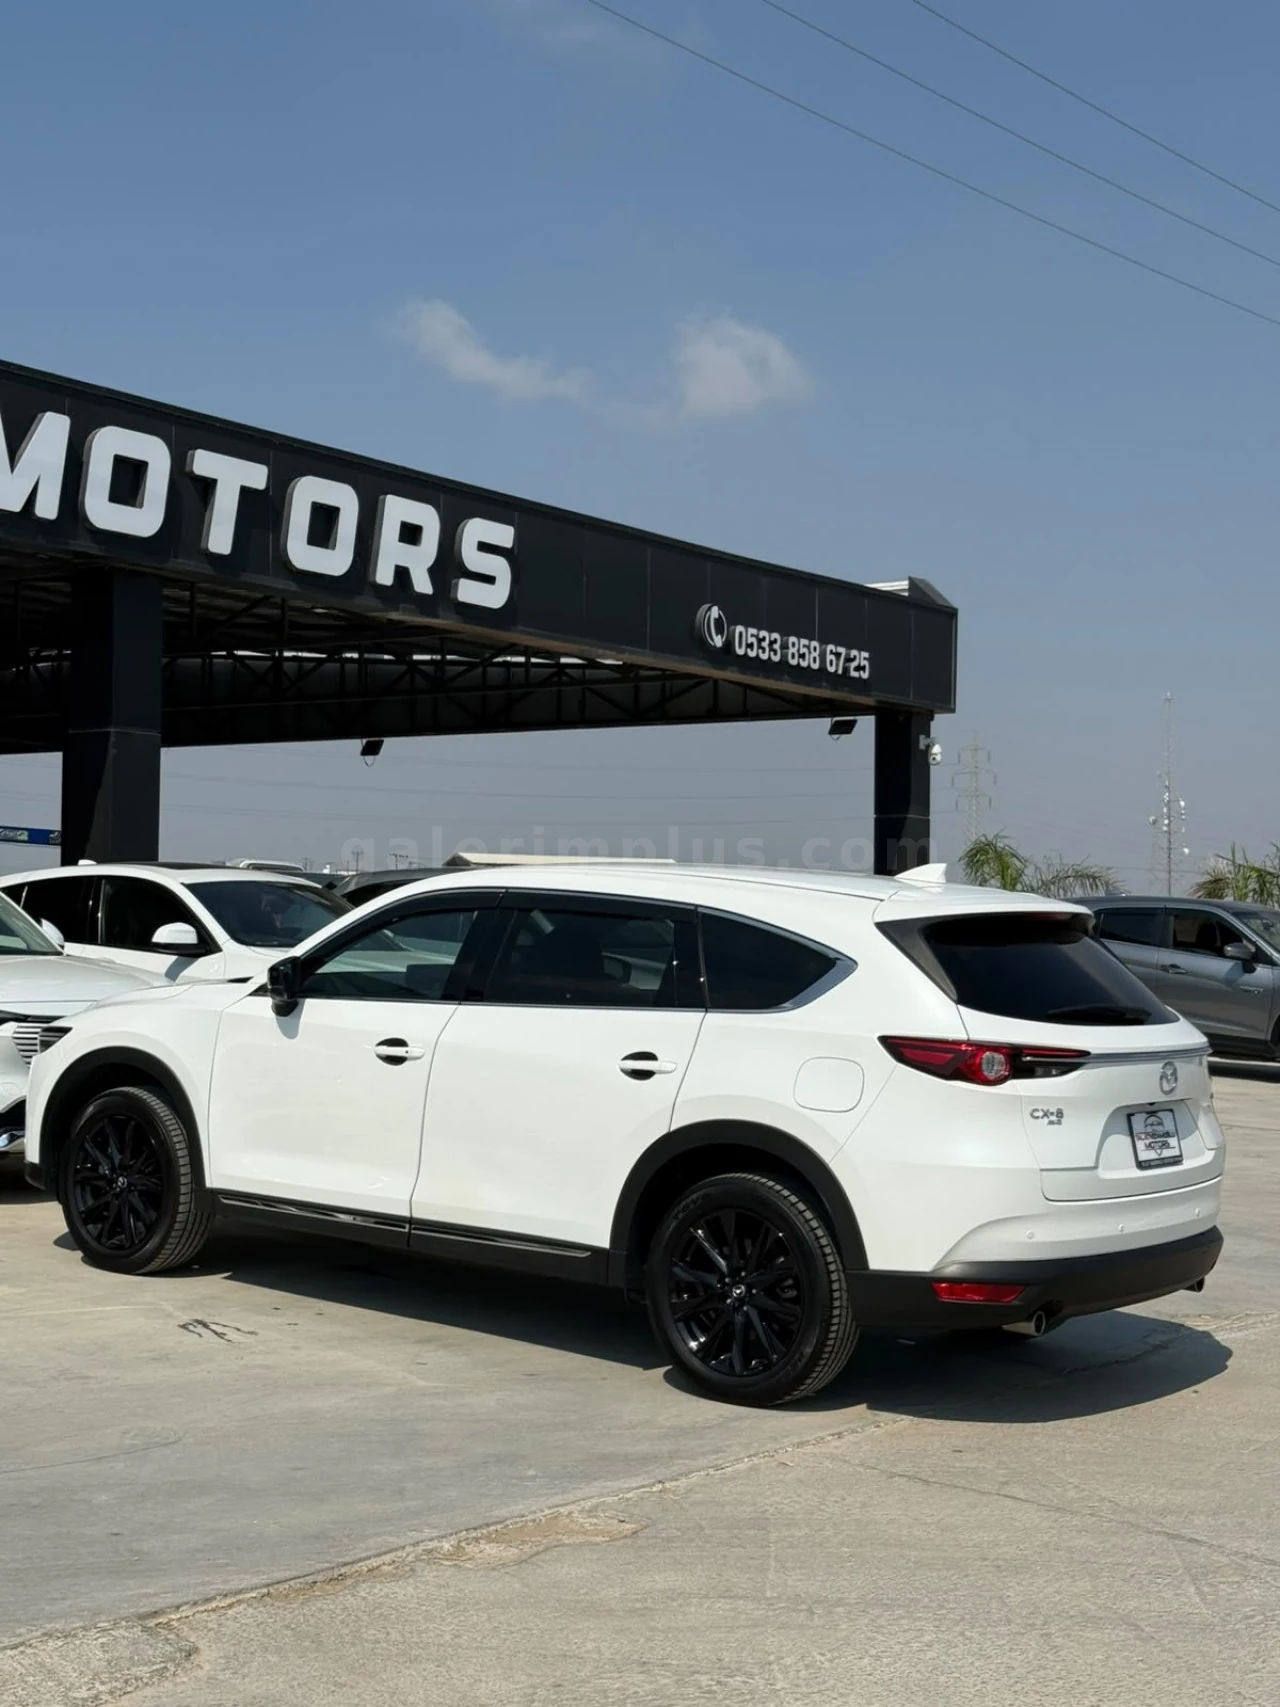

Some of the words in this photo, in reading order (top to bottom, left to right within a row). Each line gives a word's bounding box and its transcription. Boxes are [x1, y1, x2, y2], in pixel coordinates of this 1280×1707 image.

[0, 411, 515, 610] MOTORS
[734, 625, 781, 662] 0533
[787, 636, 820, 670] 858
[1030, 1108, 1064, 1119] CX-8
